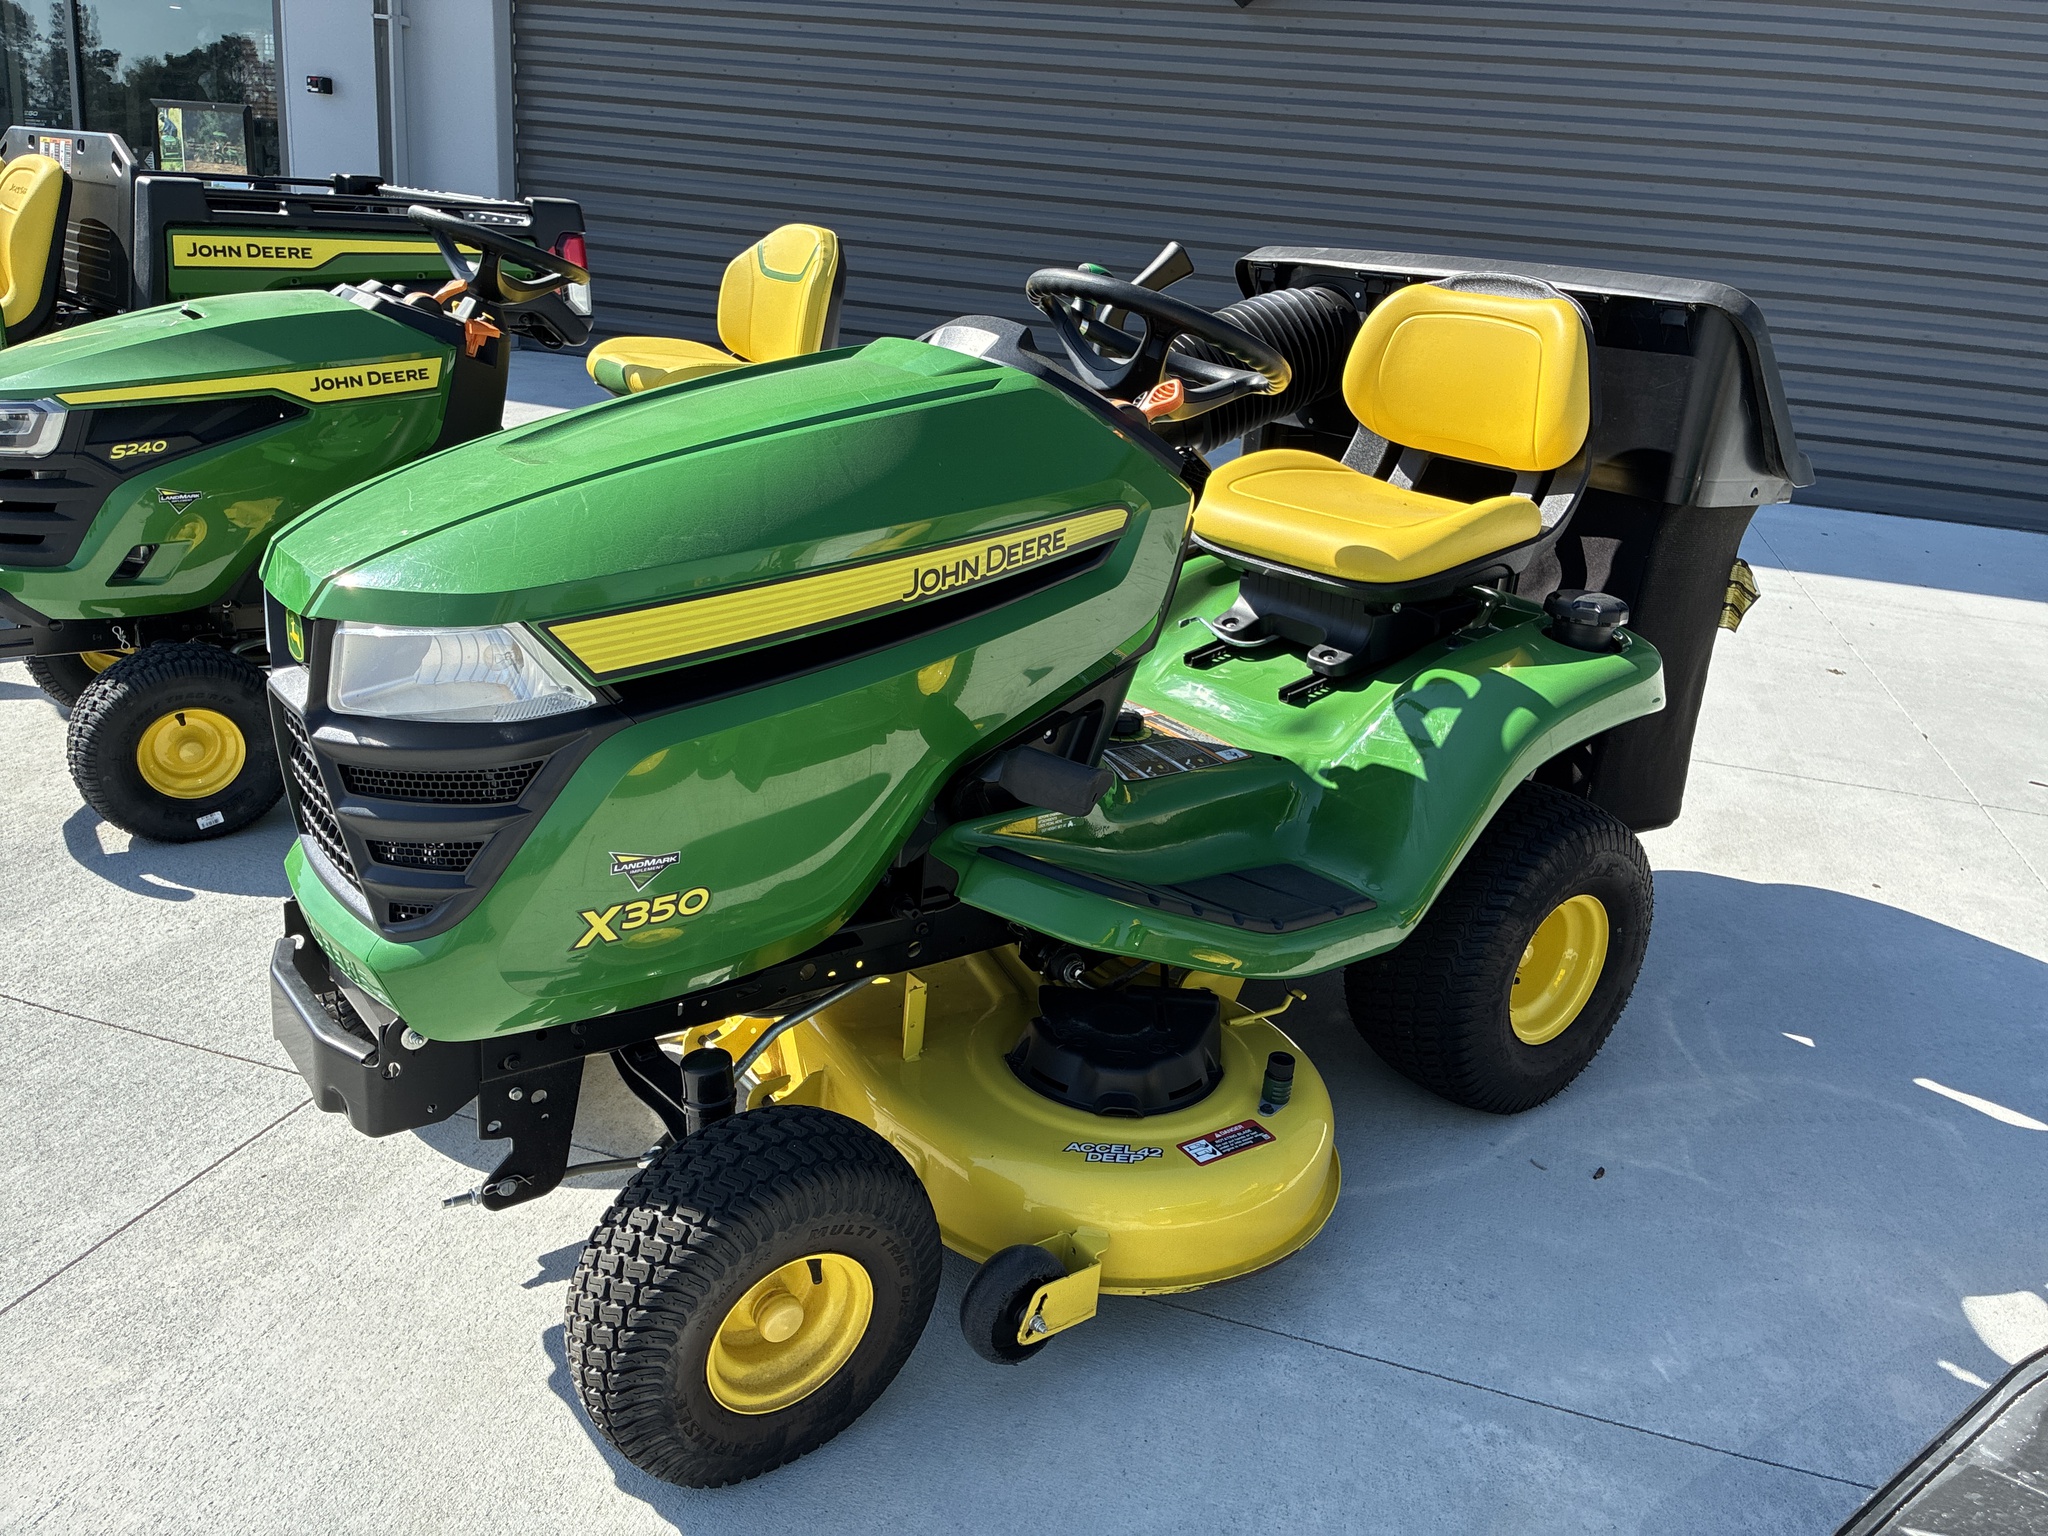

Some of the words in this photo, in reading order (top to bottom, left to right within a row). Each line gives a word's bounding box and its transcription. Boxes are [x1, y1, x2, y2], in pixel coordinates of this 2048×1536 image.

[187, 242, 242, 258] JOHN
[246, 243, 313, 259] DEERE
[310, 375, 363, 392] JOHN
[367, 368, 429, 386] DEERE
[110, 440, 167, 459] S240
[903, 555, 980, 599] JOHN
[986, 528, 1067, 574] DEERE
[629, 865, 664, 874] IMPLEMENT
[571, 887, 711, 950] X350
[1063, 1142, 1136, 1154] ACCEL
[1137, 1147, 1163, 1158] 42
[1086, 1152, 1144, 1163] DEEP
[808, 1223, 878, 1242] MULTI
[880, 1235, 911, 1278] TRAC
[673, 1392, 764, 1458] ARLISLE
